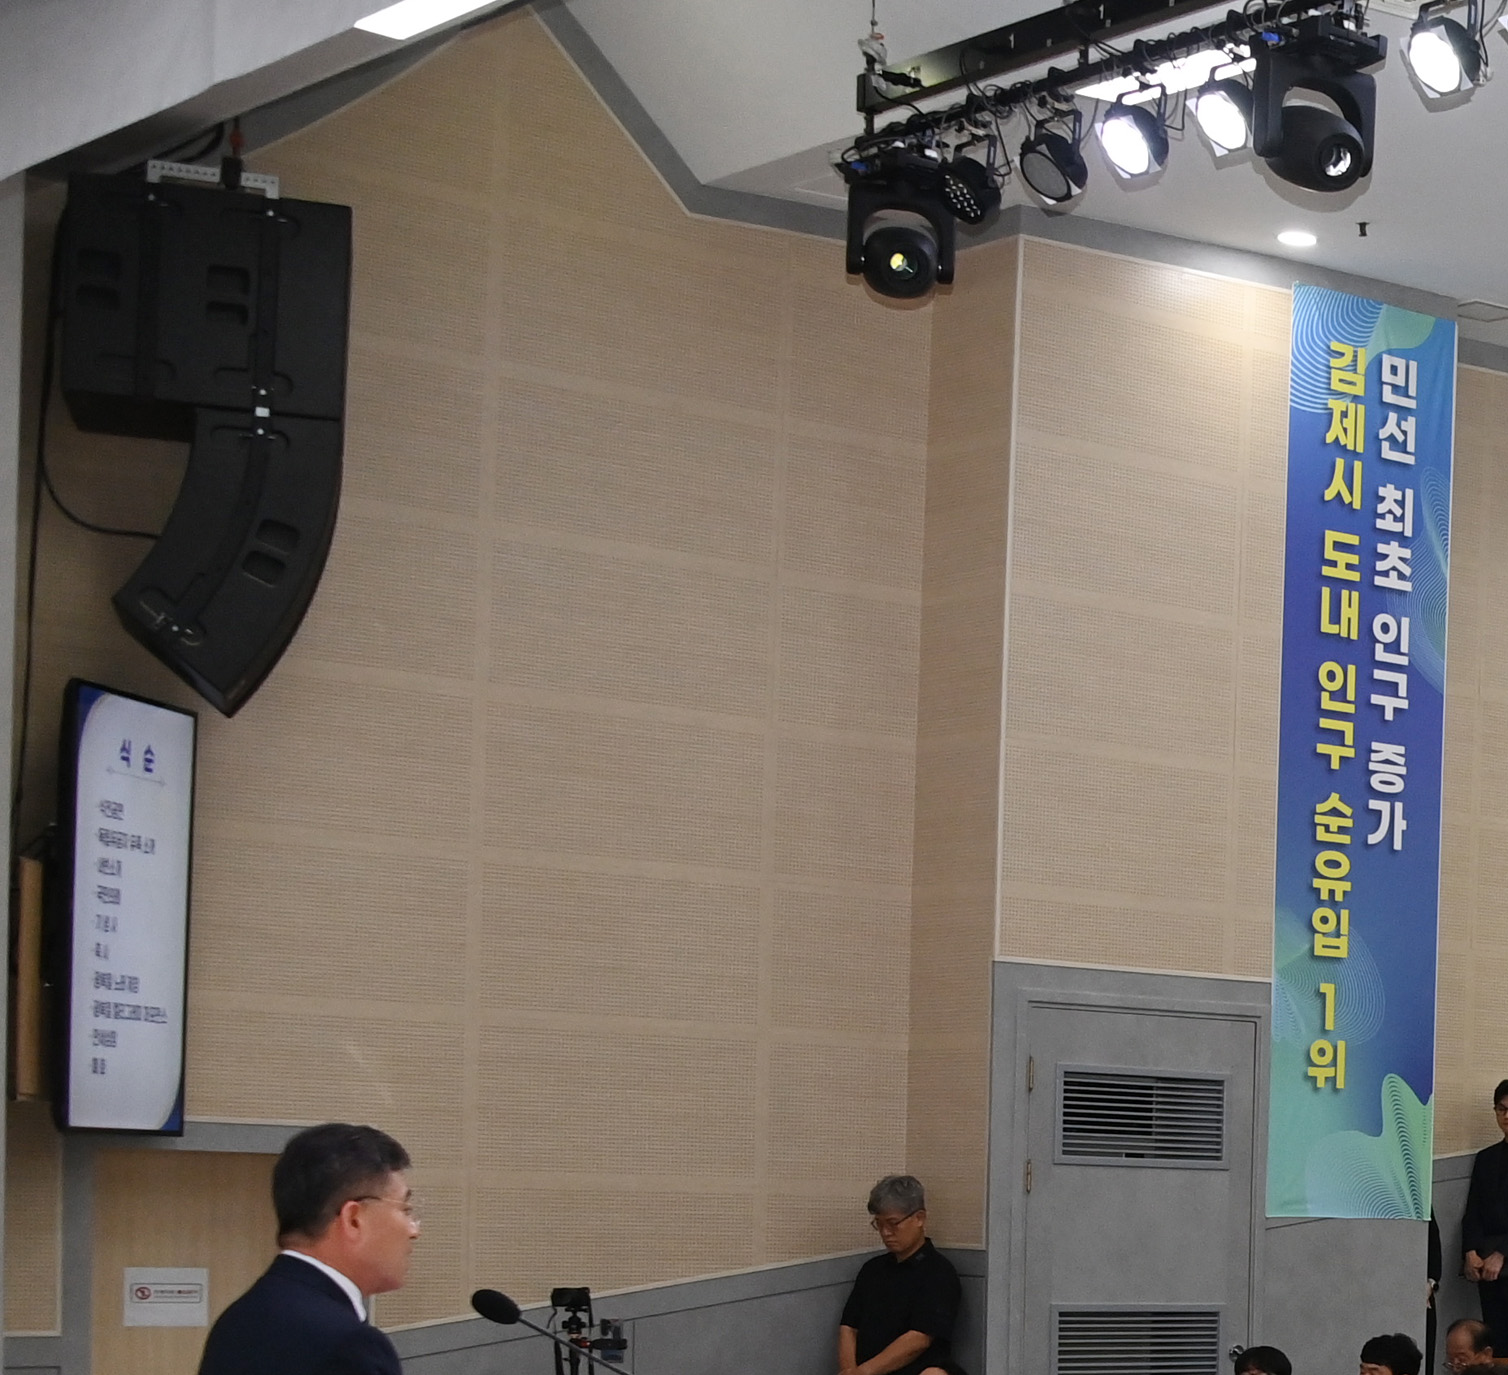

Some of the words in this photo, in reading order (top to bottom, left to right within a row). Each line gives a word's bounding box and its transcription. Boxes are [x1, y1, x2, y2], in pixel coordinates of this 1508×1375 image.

[1323, 341, 1367, 510] 김제시
[1378, 353, 1418, 466] 민선
[1319, 529, 1361, 641] 도내
[1373, 483, 1414, 593] 최초
[1315, 660, 1357, 771] 인구
[1370, 613, 1411, 722] 인구
[1366, 741, 1407, 851] 증가
[1311, 792, 1354, 959] 순유입
[1307, 983, 1347, 1090] 1위
